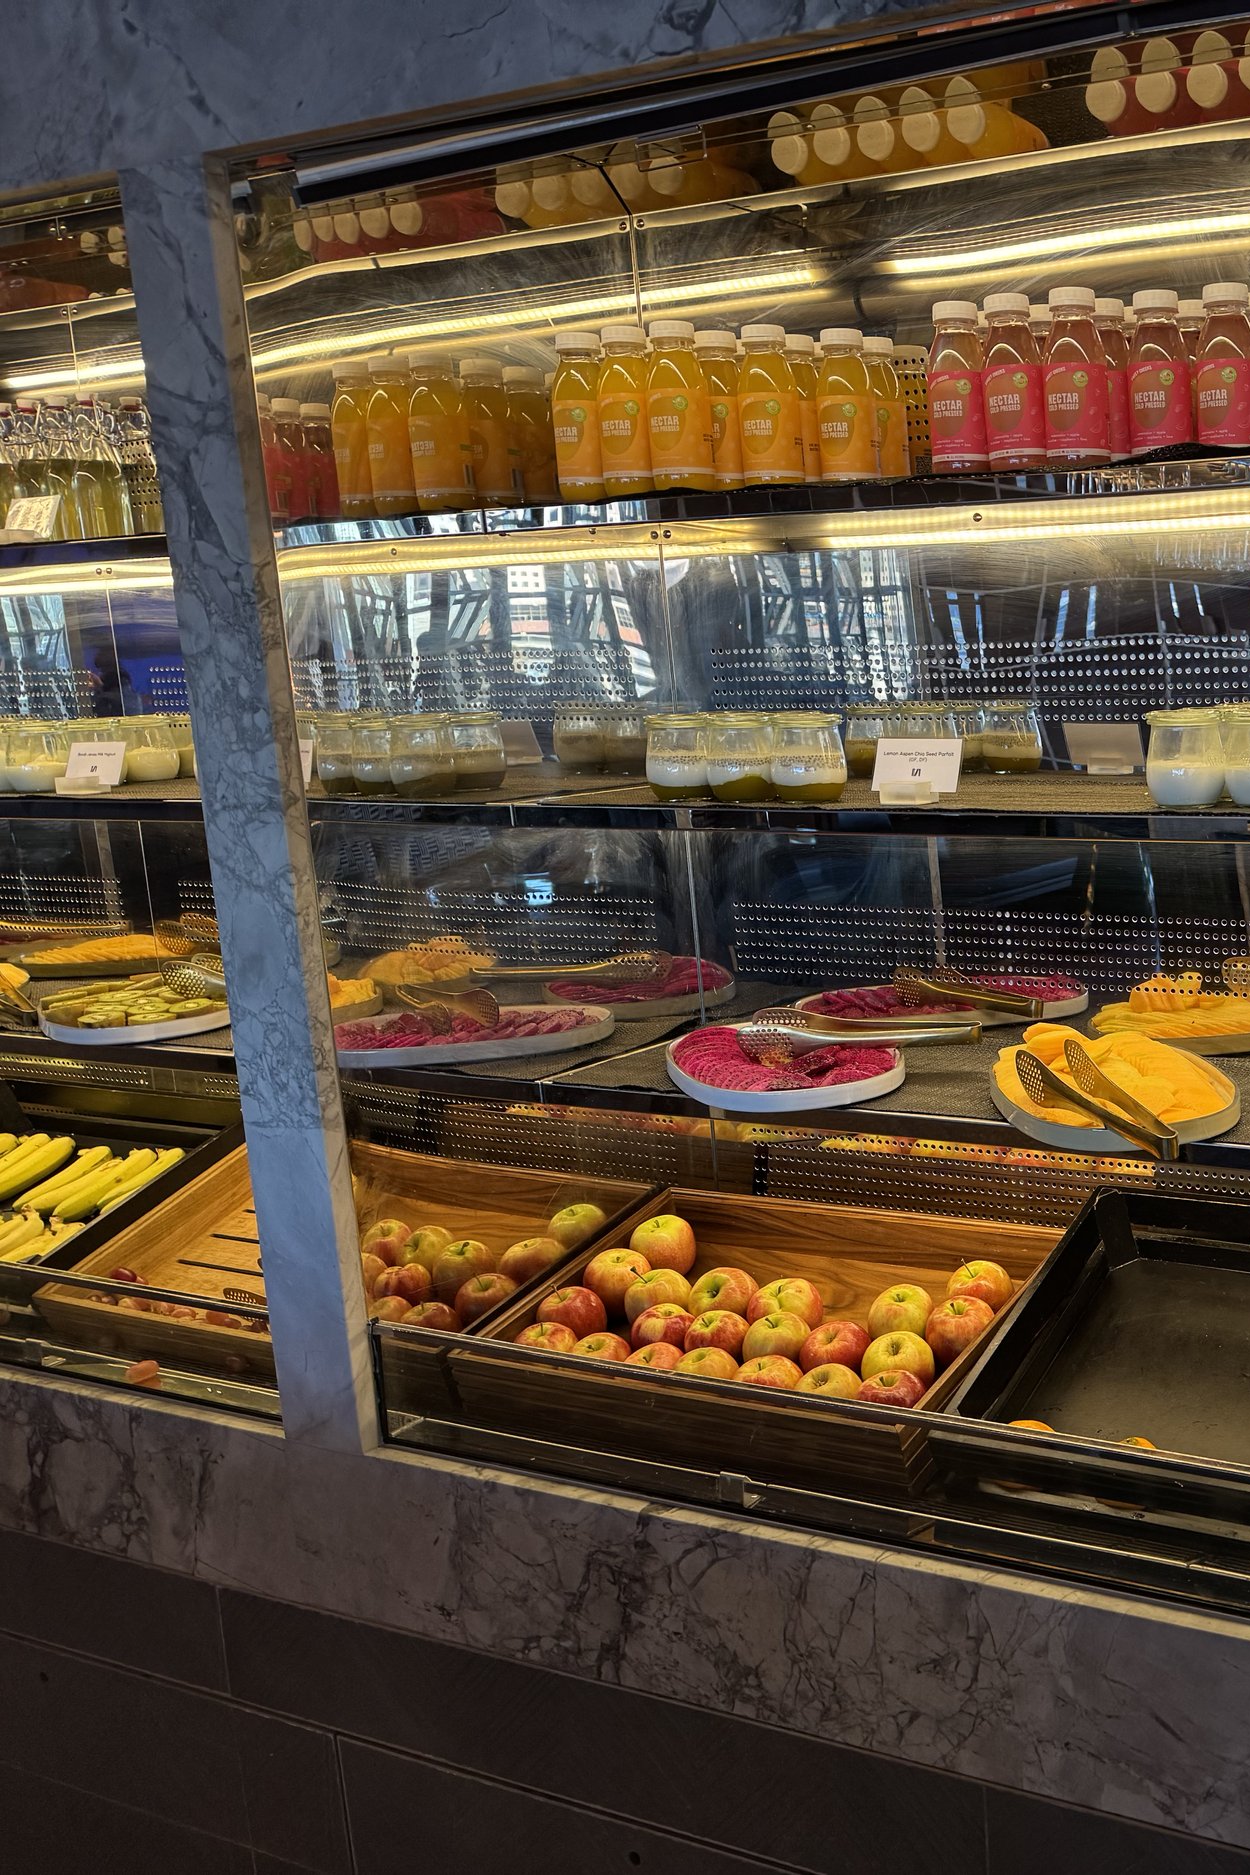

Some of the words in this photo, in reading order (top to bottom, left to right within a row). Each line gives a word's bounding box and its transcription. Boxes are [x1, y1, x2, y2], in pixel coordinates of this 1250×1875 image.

[989, 393, 1020, 406] NECTAR
[1048, 392, 1078, 404] NECTAR
[1134, 391, 1165, 404] NECTAR
[1200, 389, 1227, 402] NECTAR
[934, 400, 962, 411] NECTAR
[602, 420, 630, 430] NECTAR
[651, 416, 679, 426] NECTAR
[744, 420, 772, 430] NECTAR
[821, 422, 848, 432] NECTAR
